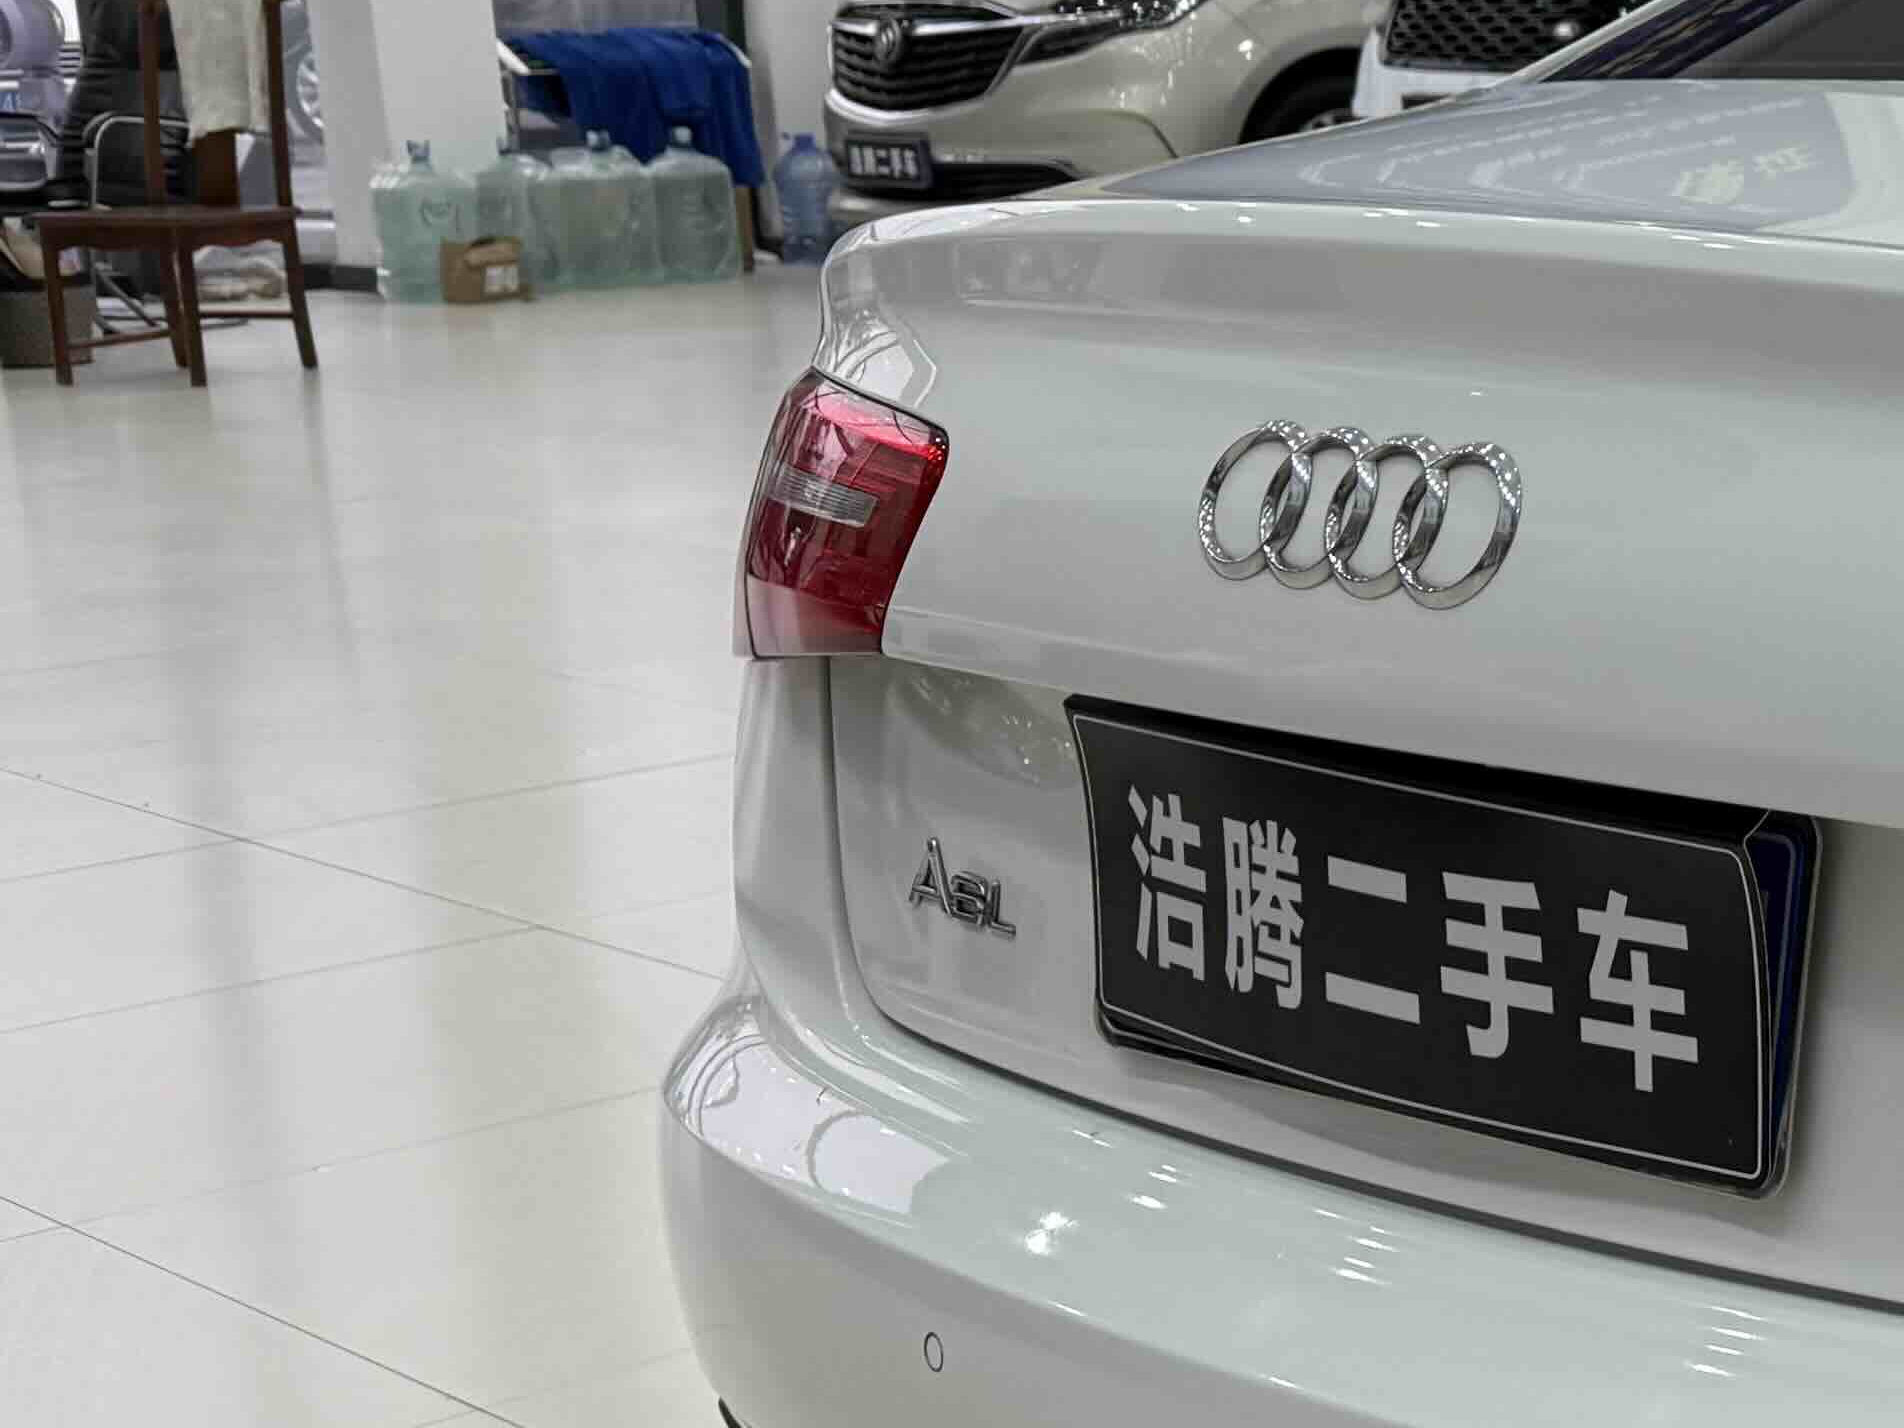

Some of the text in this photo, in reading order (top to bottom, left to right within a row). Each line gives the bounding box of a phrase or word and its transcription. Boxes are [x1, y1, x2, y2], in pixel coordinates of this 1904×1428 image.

[1128, 785, 1699, 1092] 浩腾二手车
